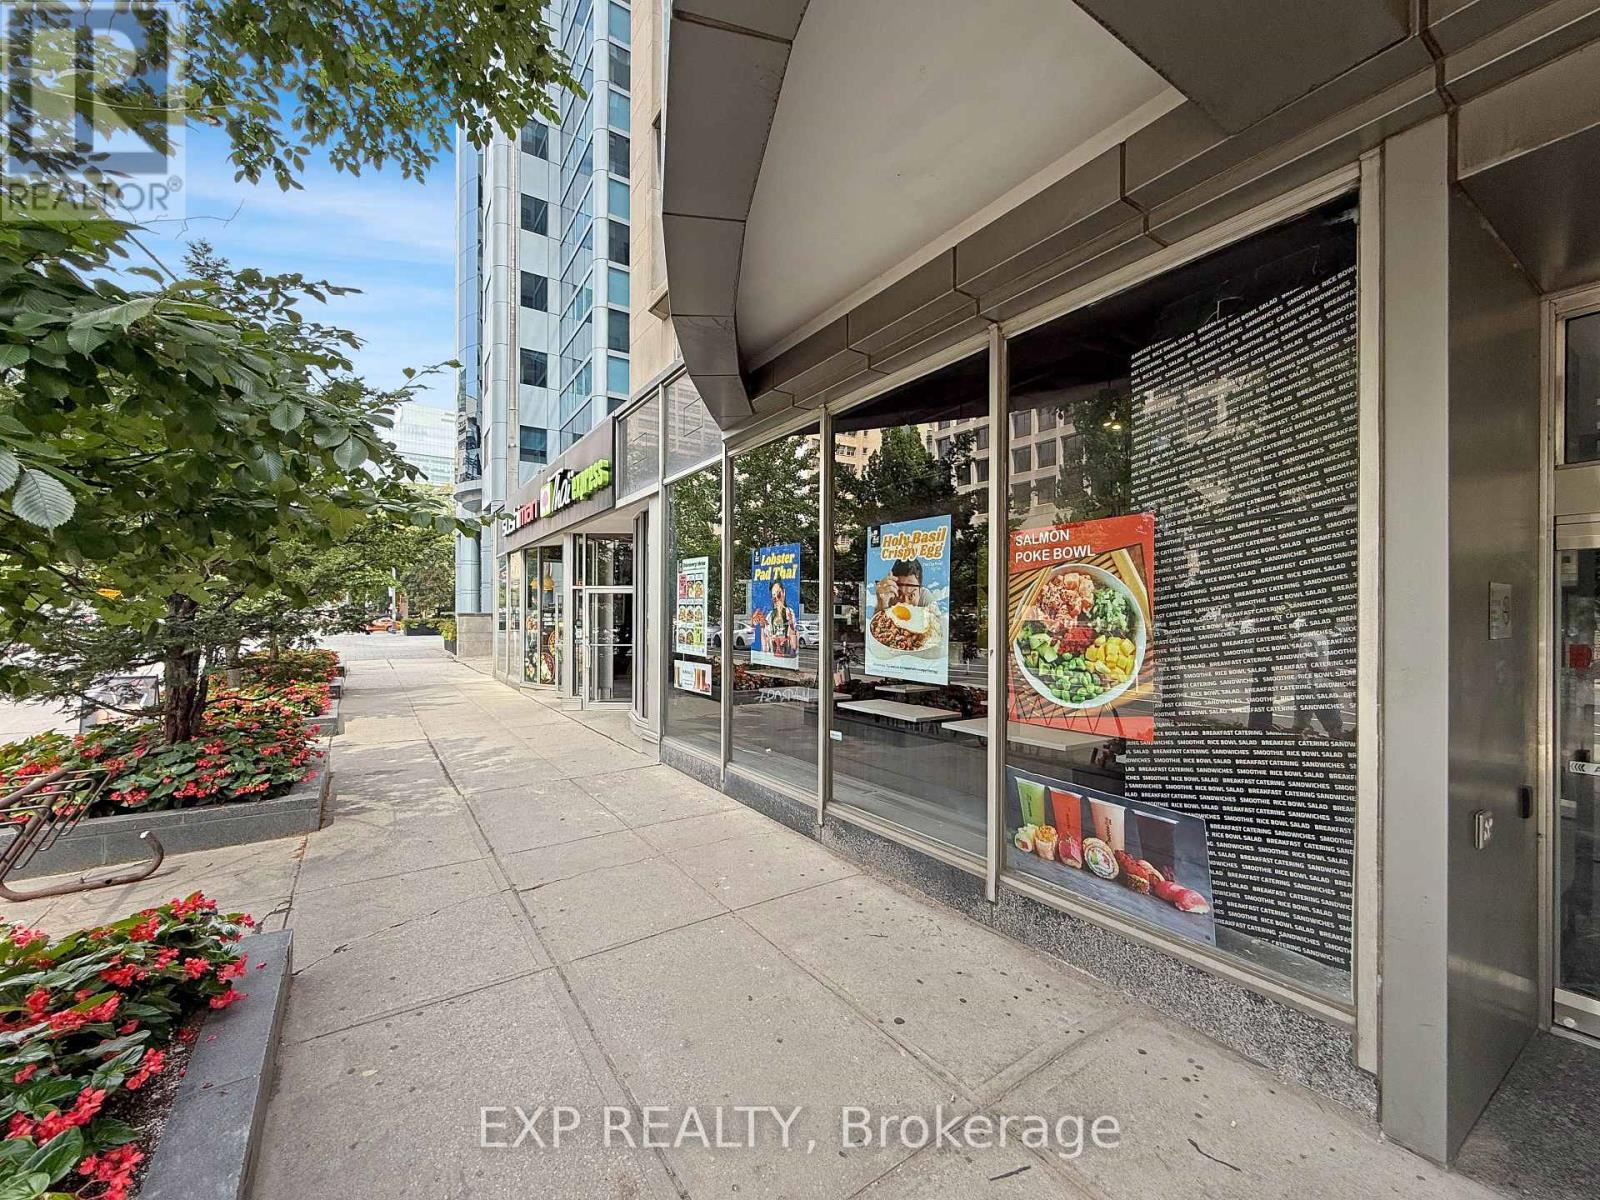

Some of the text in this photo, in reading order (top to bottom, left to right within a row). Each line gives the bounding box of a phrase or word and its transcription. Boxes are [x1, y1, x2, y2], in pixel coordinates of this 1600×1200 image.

[1241, 296, 1277, 320] BOWL SALAD
[1241, 280, 1350, 340] BREAKFAST CATERING SANDWICHES
[1245, 275, 1335, 328] SANDWICHES SMOOTHIE RICE
[1265, 307, 1319, 338] RICE BOWL SALAD
[1250, 317, 1321, 356] CATERING SANDWICHES
[1269, 327, 1347, 367] SANDWICHES SMOOTHIE
[1251, 337, 1303, 366] RICE BOWL SALAD
[1266, 341, 1338, 378] CATERING SANDWICHES
[1255, 366, 1308, 393] RICE BOWL SALAD
[1270, 376, 1311, 397] SANDWICHES
[1254, 394, 1292, 414] BOWL SALAD
[1258, 387, 1335, 423] SANDWICHES SMOOTHIE
[1254, 417, 1287, 434] BREAKFAST
[1279, 410, 1335, 435] RICE BOWL SALAD
[1262, 420, 1338, 451] CATERING SANDWICHES
[1263, 438, 1318, 461] RICE BOWL SALAD
[1274, 449, 1350, 478] CATERING SANDWICHES
[1263, 470, 1318, 491] RICE BOWL SALAD
[1278, 480, 1321, 497] SANDWICHES
[882, 531, 910, 548] Holy
[912, 526, 947, 545] Basil
[1015, 529, 1070, 547] SALMON
[1260, 540, 1301, 553] BOWL SALAD
[761, 552, 795, 567] Lobster
[881, 543, 944, 562] Crispy Egg
[1015, 544, 1095, 563] POKE BOWL
[1264, 540, 1346, 563] SANDWICHES SMOOTHIE
[753, 566, 772, 582] Pad
[1260, 561, 1296, 573] BREAKFAST
[1302, 567, 1322, 576] BOWL
[1323, 562, 1345, 572] SALAD
[1268, 573, 1348, 592] CATERING SANDWICHES
[1284, 591, 1303, 599] BOWL
[1305, 587, 1326, 596] SALAD
[1255, 634, 1285, 642] CATERING
[1287, 781, 1329, 789] SANDWICHES
[1222, 805, 1254, 813] BREAKFAST
[1287, 811, 1329, 820] SANDWICHES
[1209, 823, 1315, 839] BREAKFAST CATERING SANDWICHES
[1314, 824, 1351, 833] BREAKFAST
[1215, 841, 1253, 851] SANDWICHES
[1258, 846, 1289, 855] SMOOTHIE
[1307, 853, 1325, 861] BOWL
[1327, 856, 1348, 864] SALAD
[1266, 837, 1300, 847] BREAKFAST
[1303, 842, 1335, 851] CATERING
[1239, 854, 1349, 876] BREAKFAST CATERING SANDWICHES
[1241, 863, 1329, 883] SMOOTHIE RICE BOWL SALAD
[1227, 871, 1335, 895] BREAKFAST CATERING SANDWICHES
[1229, 882, 1320, 903] SALAD BREAKFAST CATERING
[1226, 900, 1334, 927] BREAKFAST CATERING SANDWICHES
[1244, 894, 1332, 916] SMOOTHIE RICE BOWL SALAD
[1227, 910, 1314, 934] SMOOTHIE RICE BOWL SALAD
[1246, 923, 1319, 945] CATERING SANDWICHES
